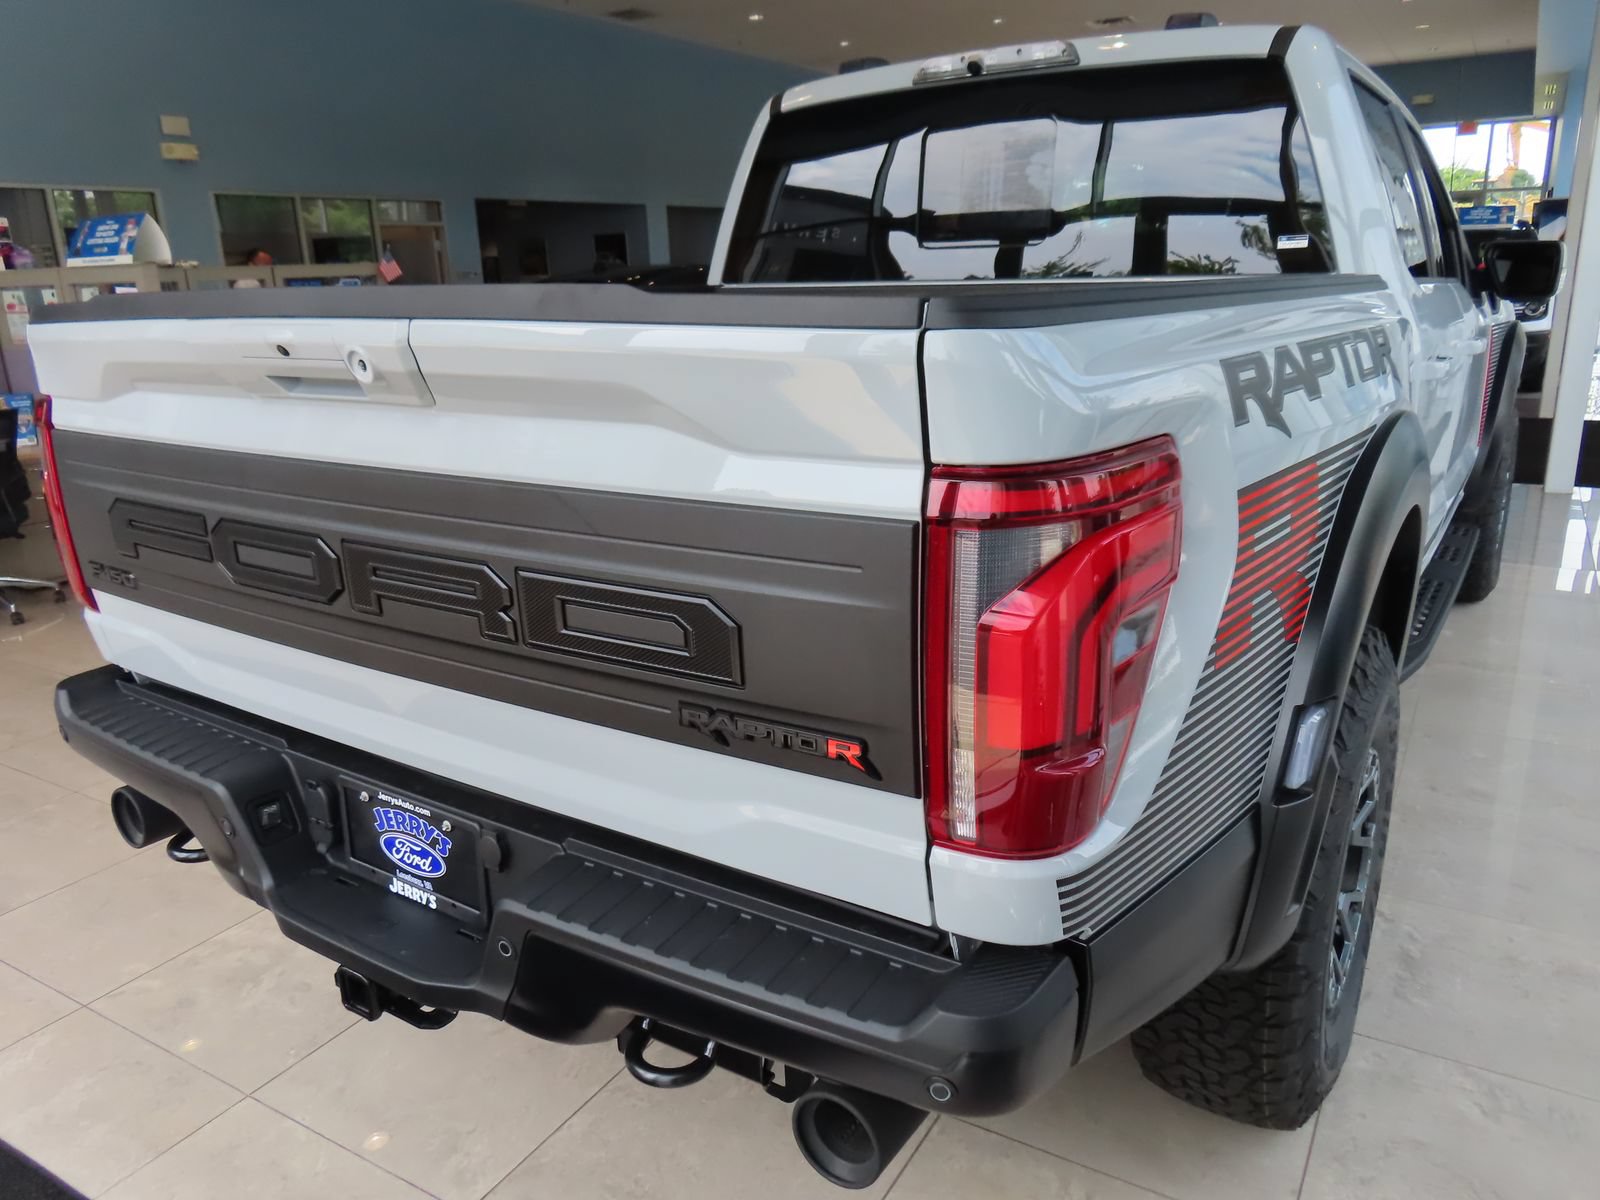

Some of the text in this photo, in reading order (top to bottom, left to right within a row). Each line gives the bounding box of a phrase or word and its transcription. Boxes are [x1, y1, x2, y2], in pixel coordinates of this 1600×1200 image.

[1220, 327, 1400, 438] RAPTOR
[110, 499, 745, 688] FORD
[680, 701, 882, 780] RAPTOR
[378, 793, 430, 817] JerrysAuto.com
[374, 808, 451, 856] JERRY'S
[393, 839, 432, 871] Ford
[389, 878, 437, 909] JERRY'S
